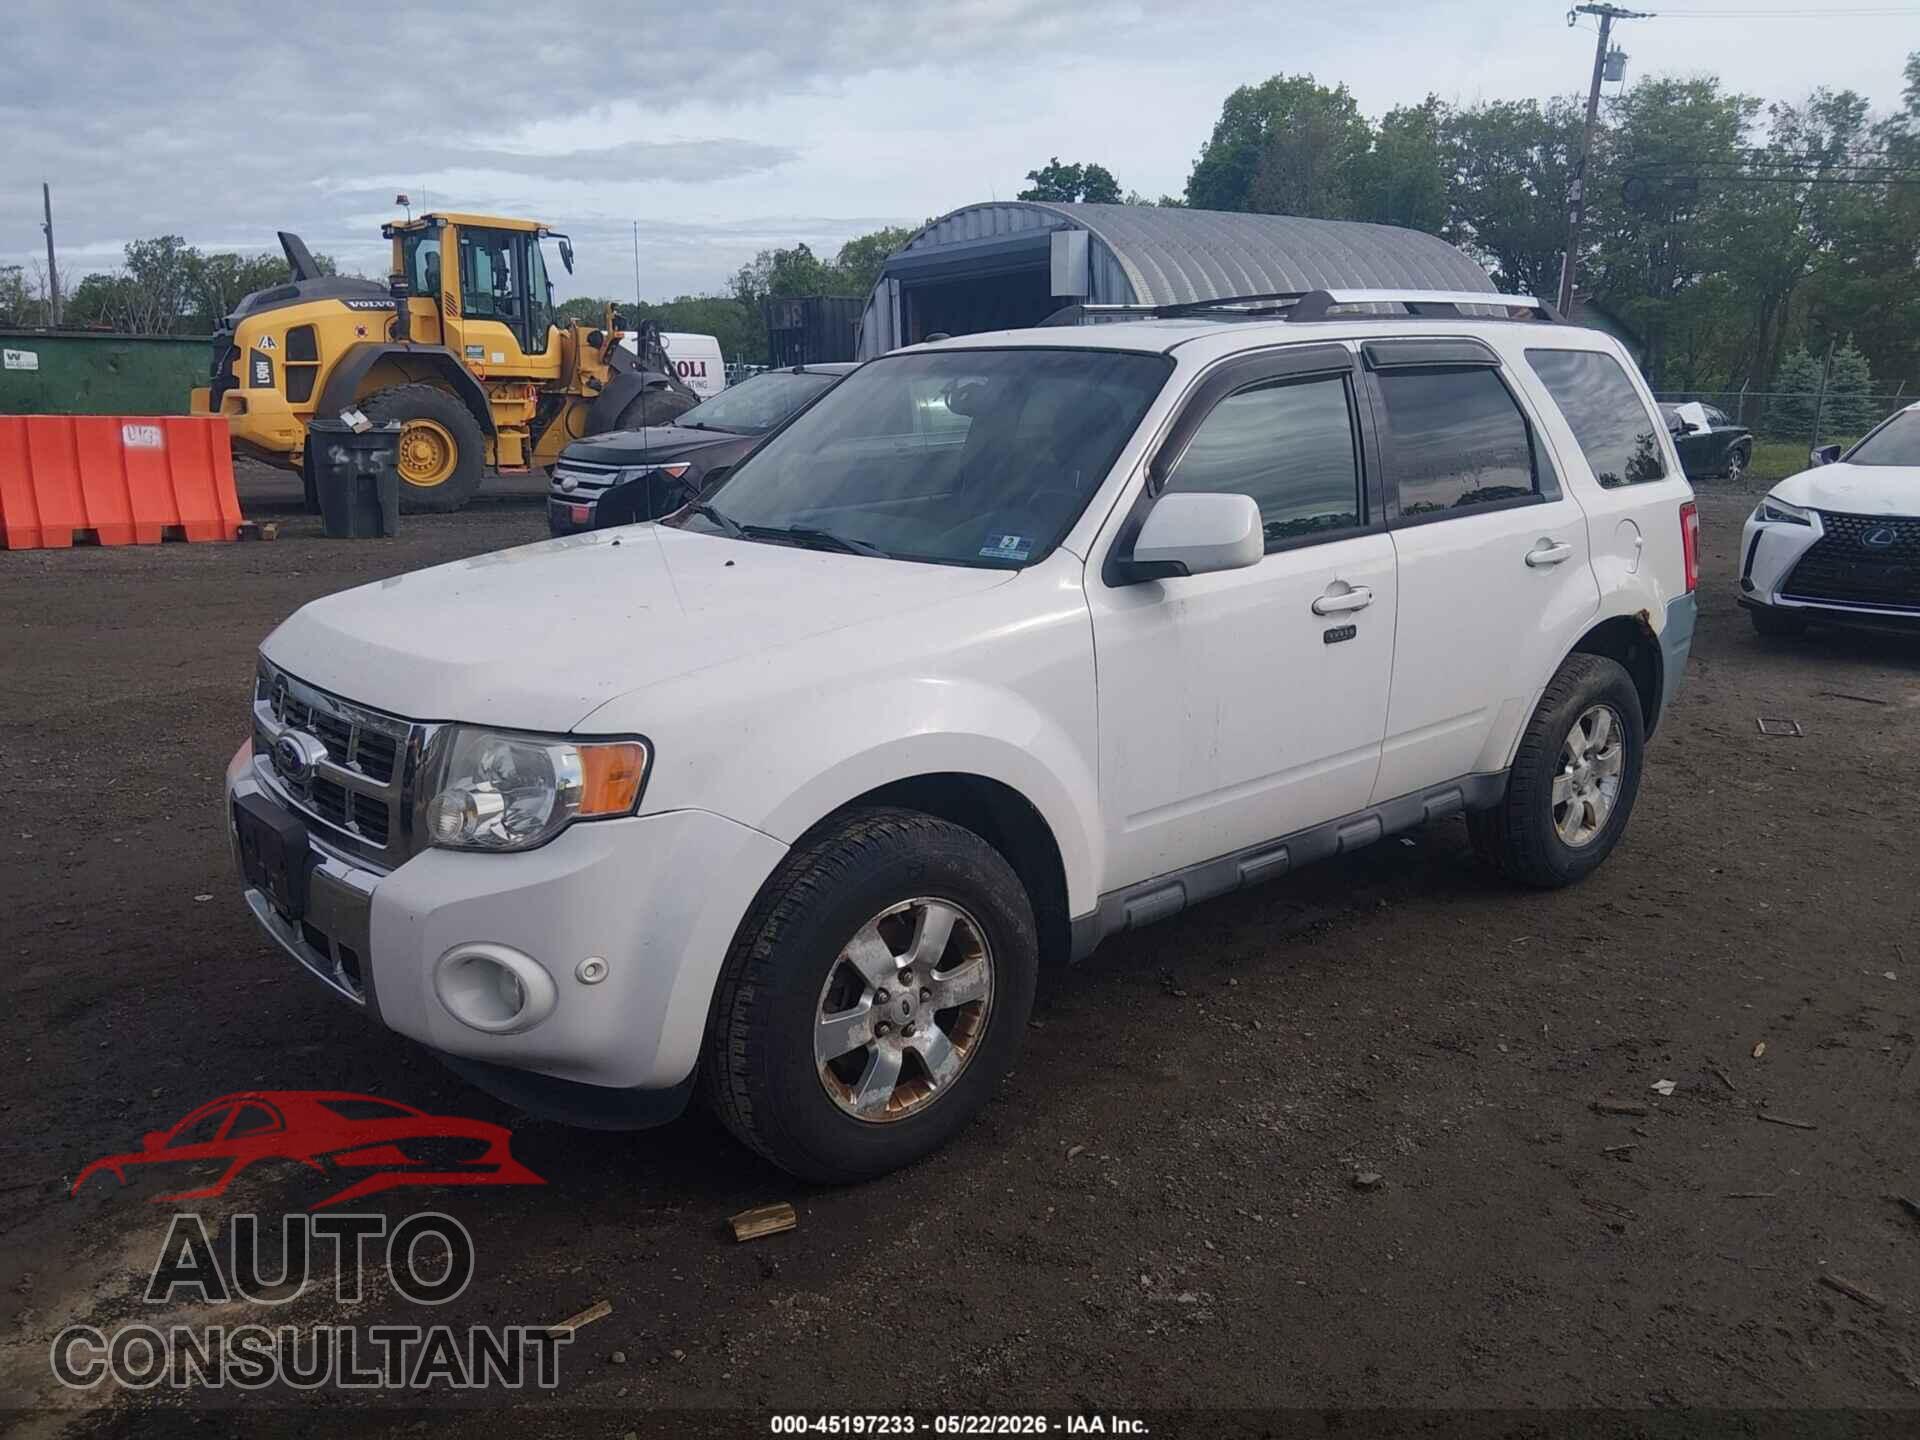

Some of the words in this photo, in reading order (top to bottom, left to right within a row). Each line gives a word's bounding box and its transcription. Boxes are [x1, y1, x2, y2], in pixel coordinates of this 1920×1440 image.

[349, 300, 395, 308] VOLVO
[256, 361, 270, 384] L90H
[672, 361, 706, 377] OLI
